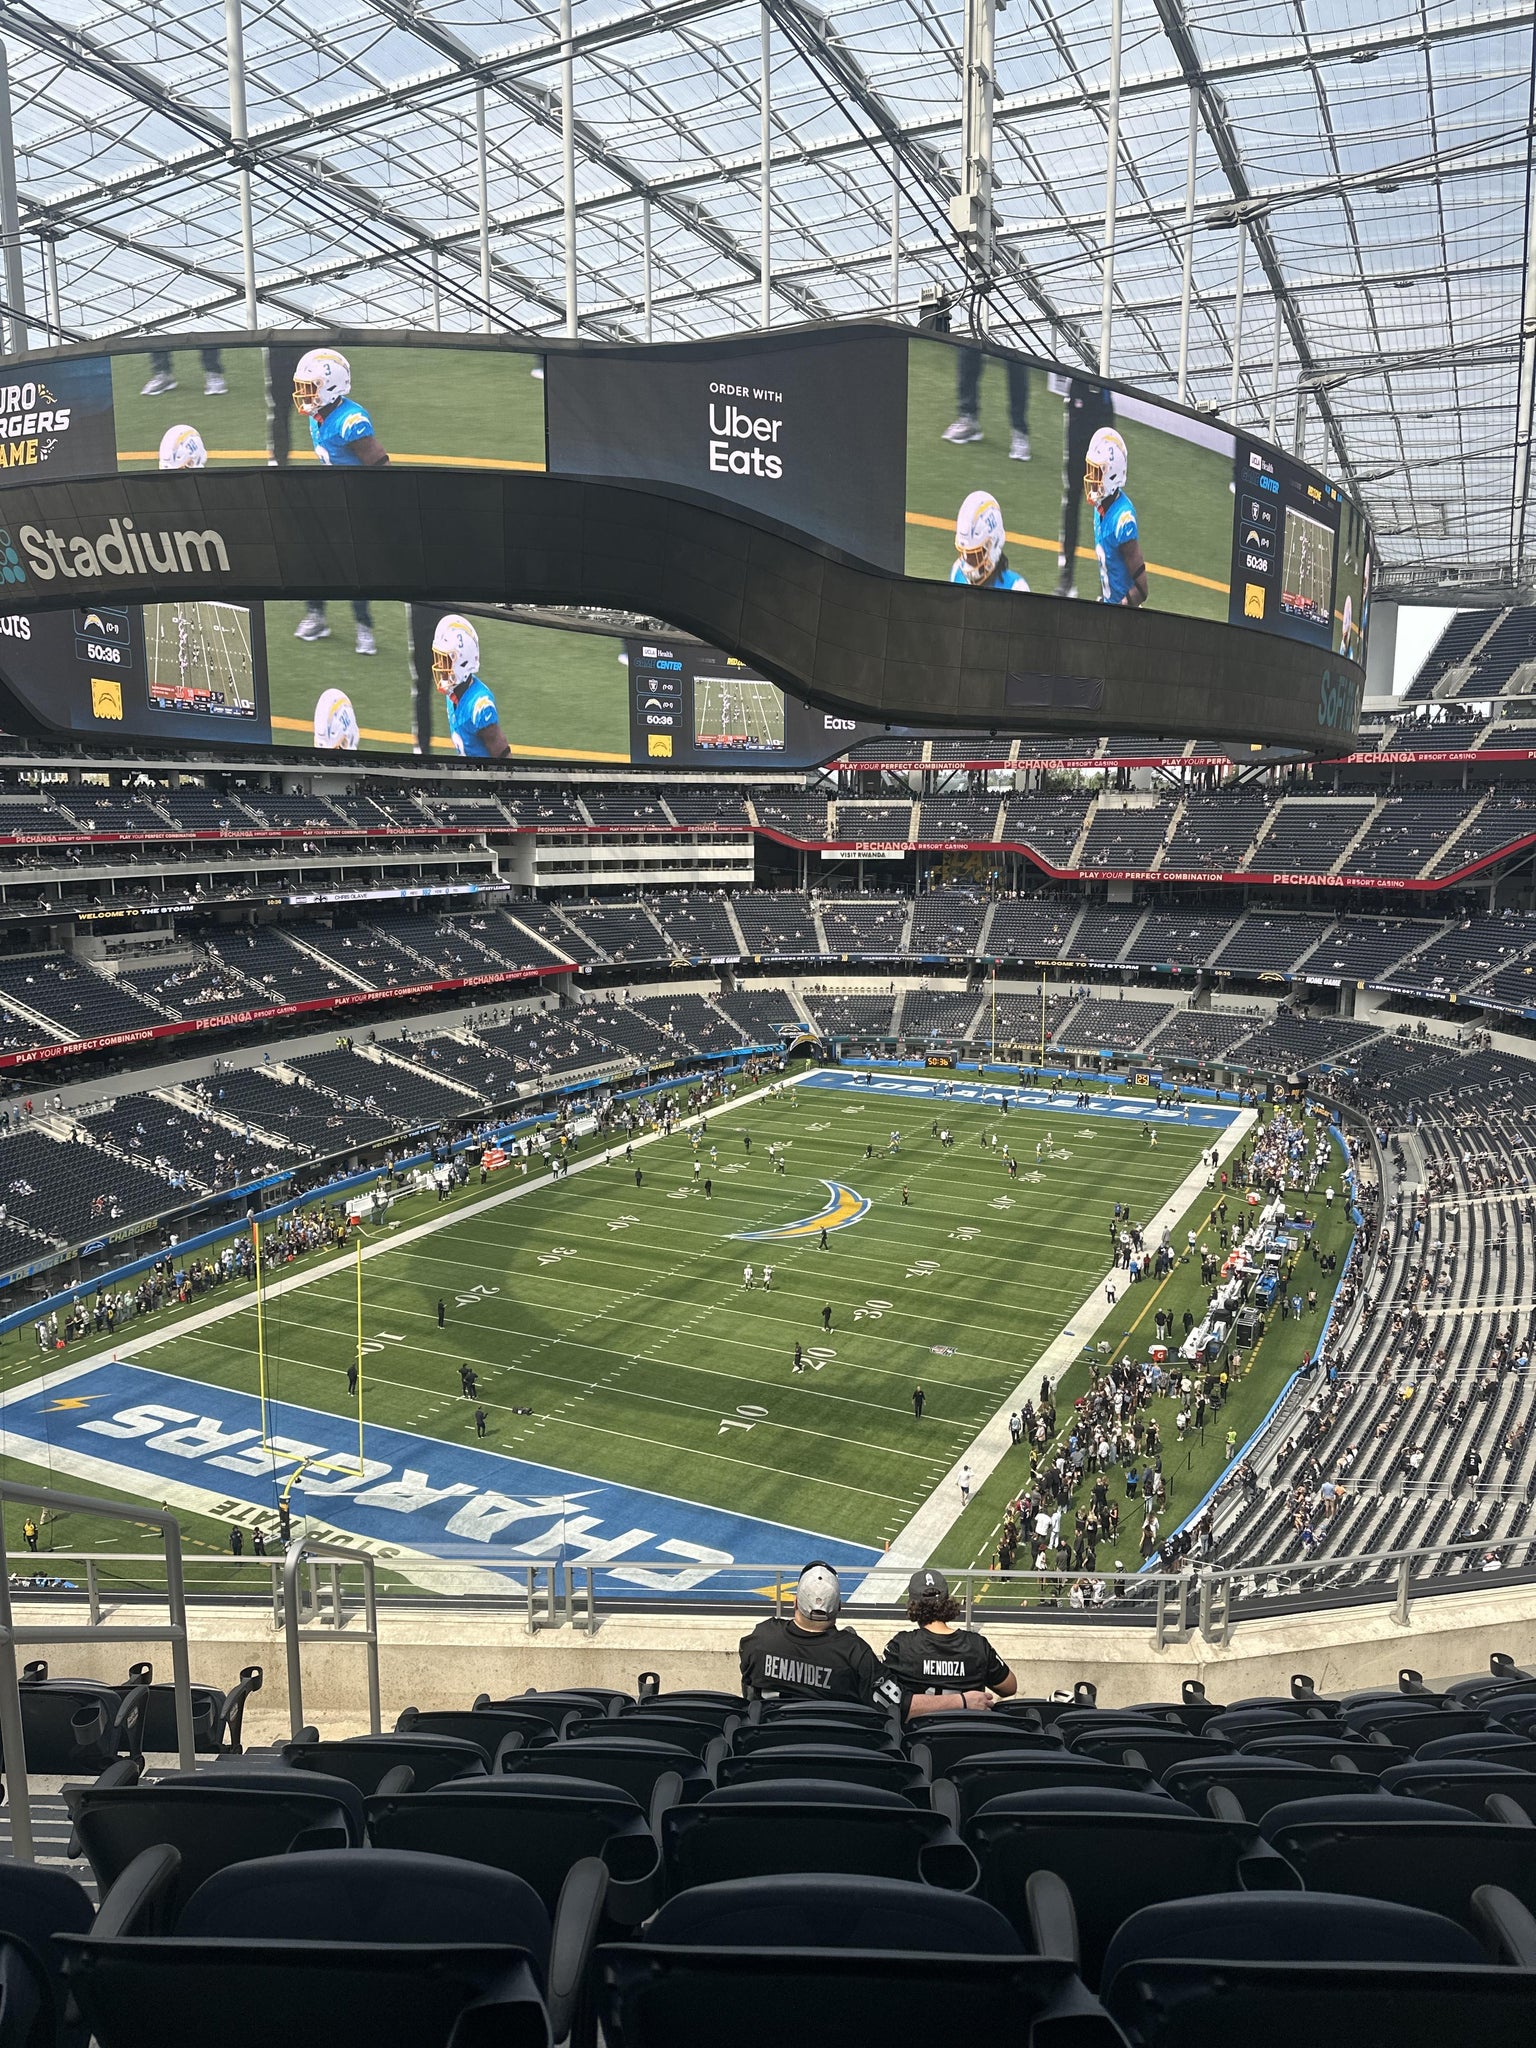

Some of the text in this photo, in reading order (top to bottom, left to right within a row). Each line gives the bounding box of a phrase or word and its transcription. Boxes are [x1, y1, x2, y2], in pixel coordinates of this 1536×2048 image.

[709, 382, 783, 403] ORDER WITH
[709, 403, 783, 443] Uber
[709, 439, 783, 479] Eats
[1259, 475, 1280, 494] CENTER
[19, 517, 231, 581] Stadium
[87, 643, 121, 664] 50:36
[657, 649, 674, 659] Health
[656, 661, 682, 671] CENTER
[646, 714, 673, 726] 50:36
[824, 714, 856, 730] Eats
[914, 762, 966, 770] COMBINATION
[1004, 760, 1064, 770] PECHANGA
[1161, 758, 1181, 766] PLAY
[1182, 758, 1206, 766] YOUR
[1348, 752, 1477, 764] PECHANGA RESORT CASINO
[16, 835, 57, 844] PECHANGA
[855, 841, 916, 851] PECHANGA
[857, 851, 886, 859] RWANDA
[1079, 871, 1099, 879] PLAY
[1125, 872, 1161, 880] PERFECT
[1163, 873, 1223, 881] COMBINATION
[1273, 874, 1344, 887] PECHANGA
[1377, 880, 1405, 888] CASINO
[78, 911, 125, 920] WELCOME
[161, 905, 194, 914] STORM
[1034, 960, 1074, 968] WELCOME
[463, 973, 505, 987] PECHANGA
[1306, 976, 1323, 985] HOME
[1324, 978, 1342, 987] GAME
[334, 984, 433, 1006] PLAY YOUR PERFECT COMBINATION
[195, 1006, 298, 1030] PECHANGA RESORT CASINO
[16, 1030, 153, 1063] PLAY YOUR PERFECT COMBINATION
[372, 1137, 400, 1149] WELCOME
[399, 1134, 408, 1142] TO
[408, 1130, 420, 1138] THE
[108, 1218, 158, 1244] CHARGERS
[947, 1226, 982, 1241] 50
[536, 1246, 578, 1263] 30
[905, 1259, 942, 1277] 40
[454, 1283, 500, 1305] 20
[852, 1299, 894, 1320] 30
[718, 1404, 769, 1433] 10
[76, 1404, 735, 1592] CHARGERS
[764, 1653, 832, 1690] BENAVIDEZ
[922, 1659, 966, 1677] MENDOZA
[872, 1678, 902, 1709] 18
